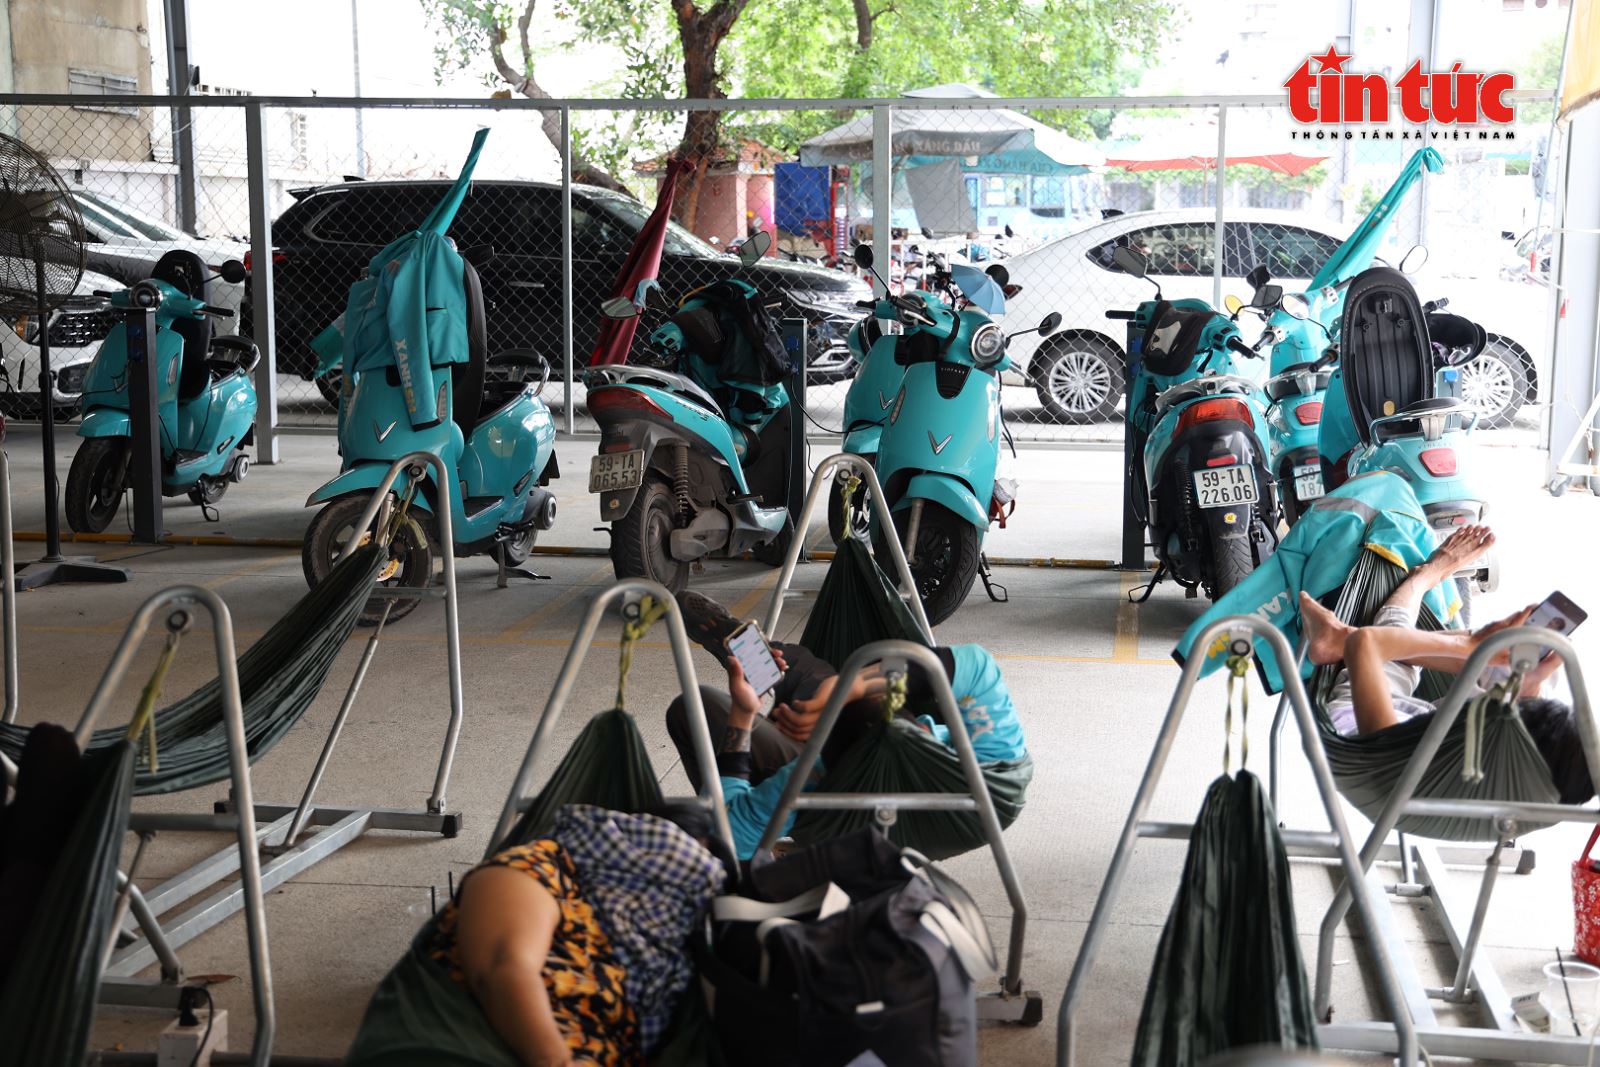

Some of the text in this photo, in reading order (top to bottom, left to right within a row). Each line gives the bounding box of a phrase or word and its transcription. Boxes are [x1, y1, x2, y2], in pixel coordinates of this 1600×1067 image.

[599, 453, 635, 473] 59-TA
[593, 469, 638, 490] 065.53
[1201, 467, 1245, 488] 59-TA
[1201, 484, 1253, 505] 226.06
